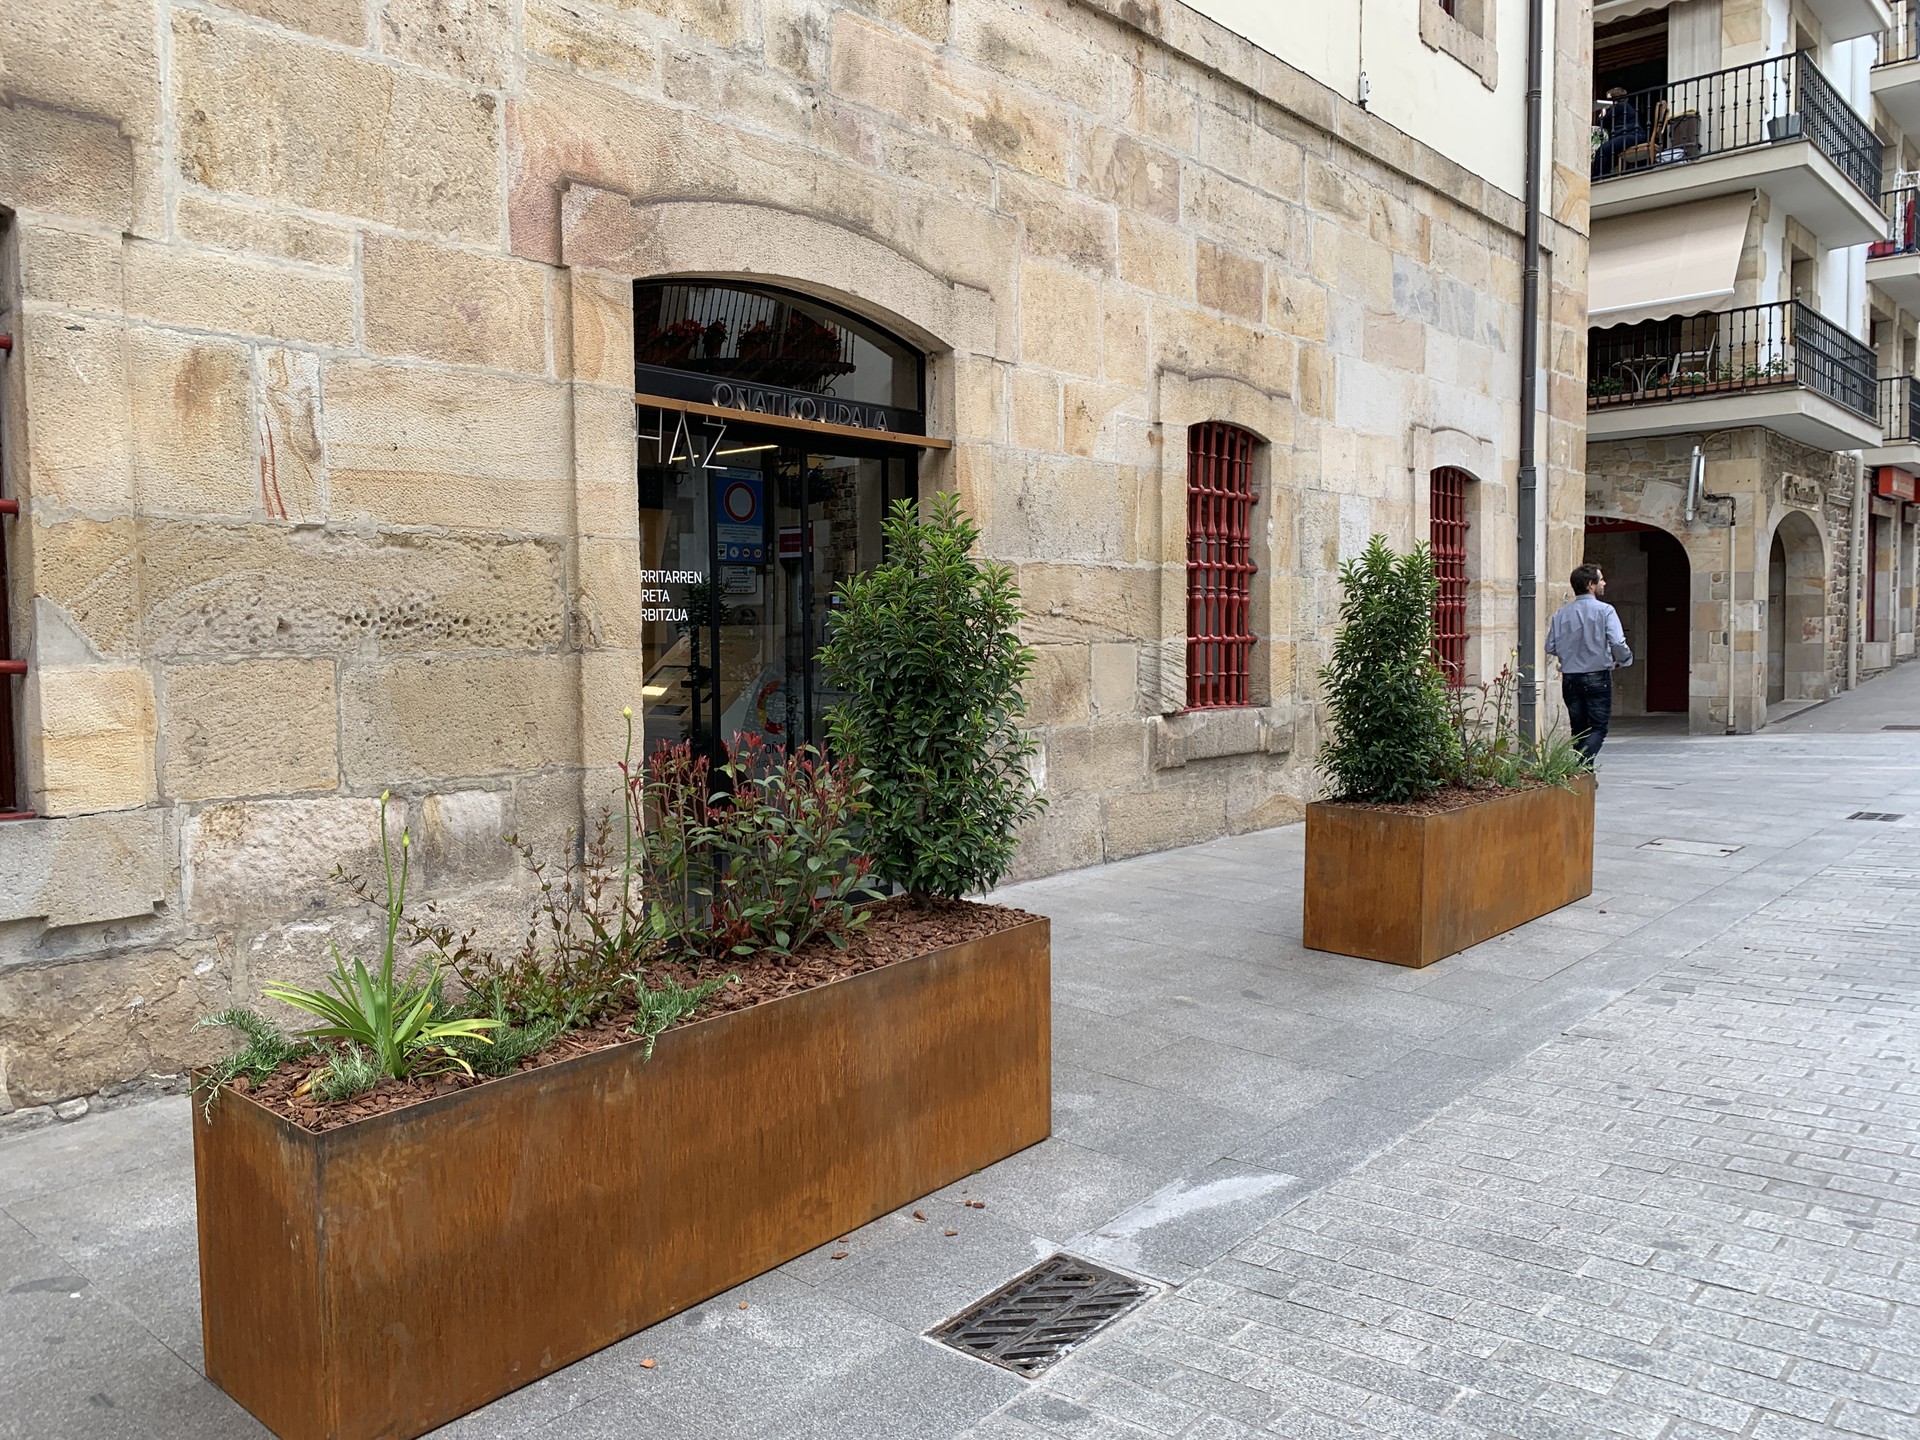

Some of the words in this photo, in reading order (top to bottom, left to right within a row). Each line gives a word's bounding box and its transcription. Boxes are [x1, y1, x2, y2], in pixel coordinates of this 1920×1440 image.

[640, 569, 702, 584] RRITARREN
[641, 589, 671, 603] RETA
[641, 608, 689, 622] RBITZUA
